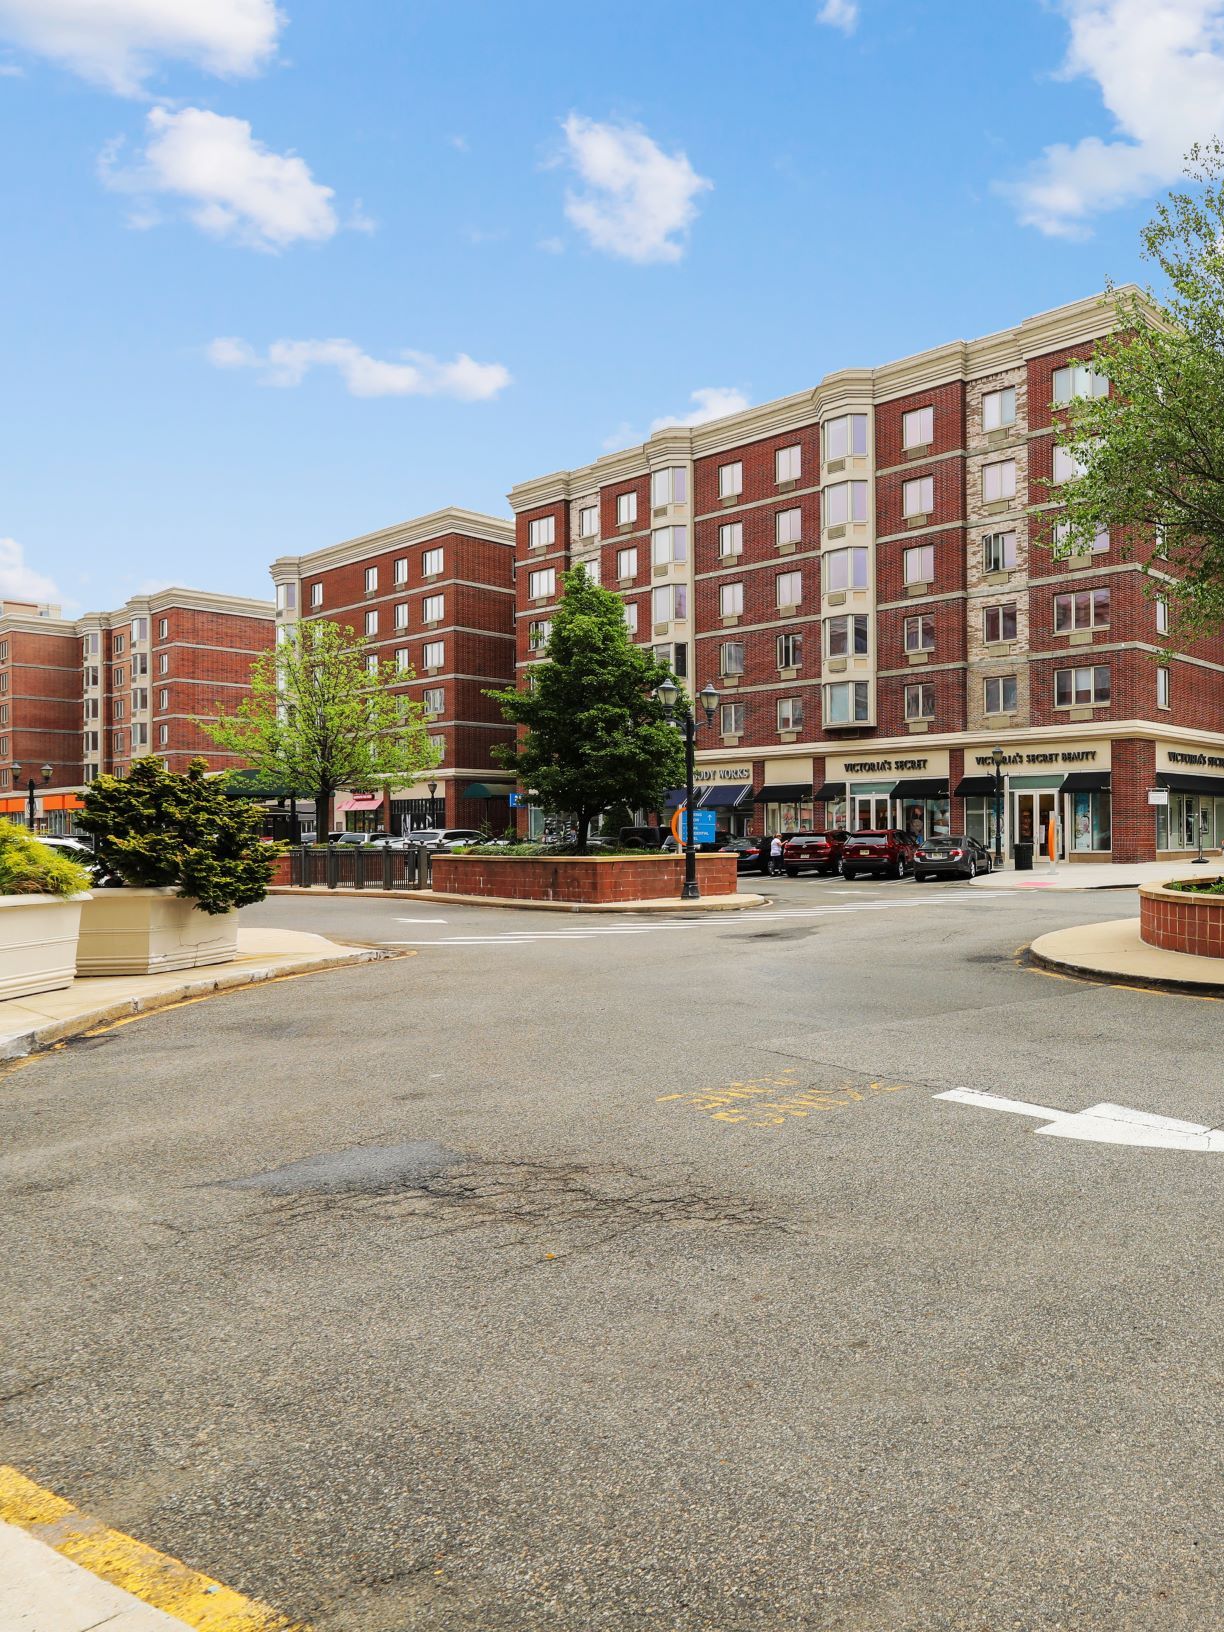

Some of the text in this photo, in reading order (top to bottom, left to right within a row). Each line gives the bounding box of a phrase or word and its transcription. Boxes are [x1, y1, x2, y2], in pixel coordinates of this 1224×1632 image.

[975, 750, 1097, 766] VICTRIA'S SECRET BEAUTY
[1167, 751, 1207, 766] VICTORIA'S
[844, 759, 928, 773] VICTORIA'S SECRET
[719, 768, 750, 780] WORKS
